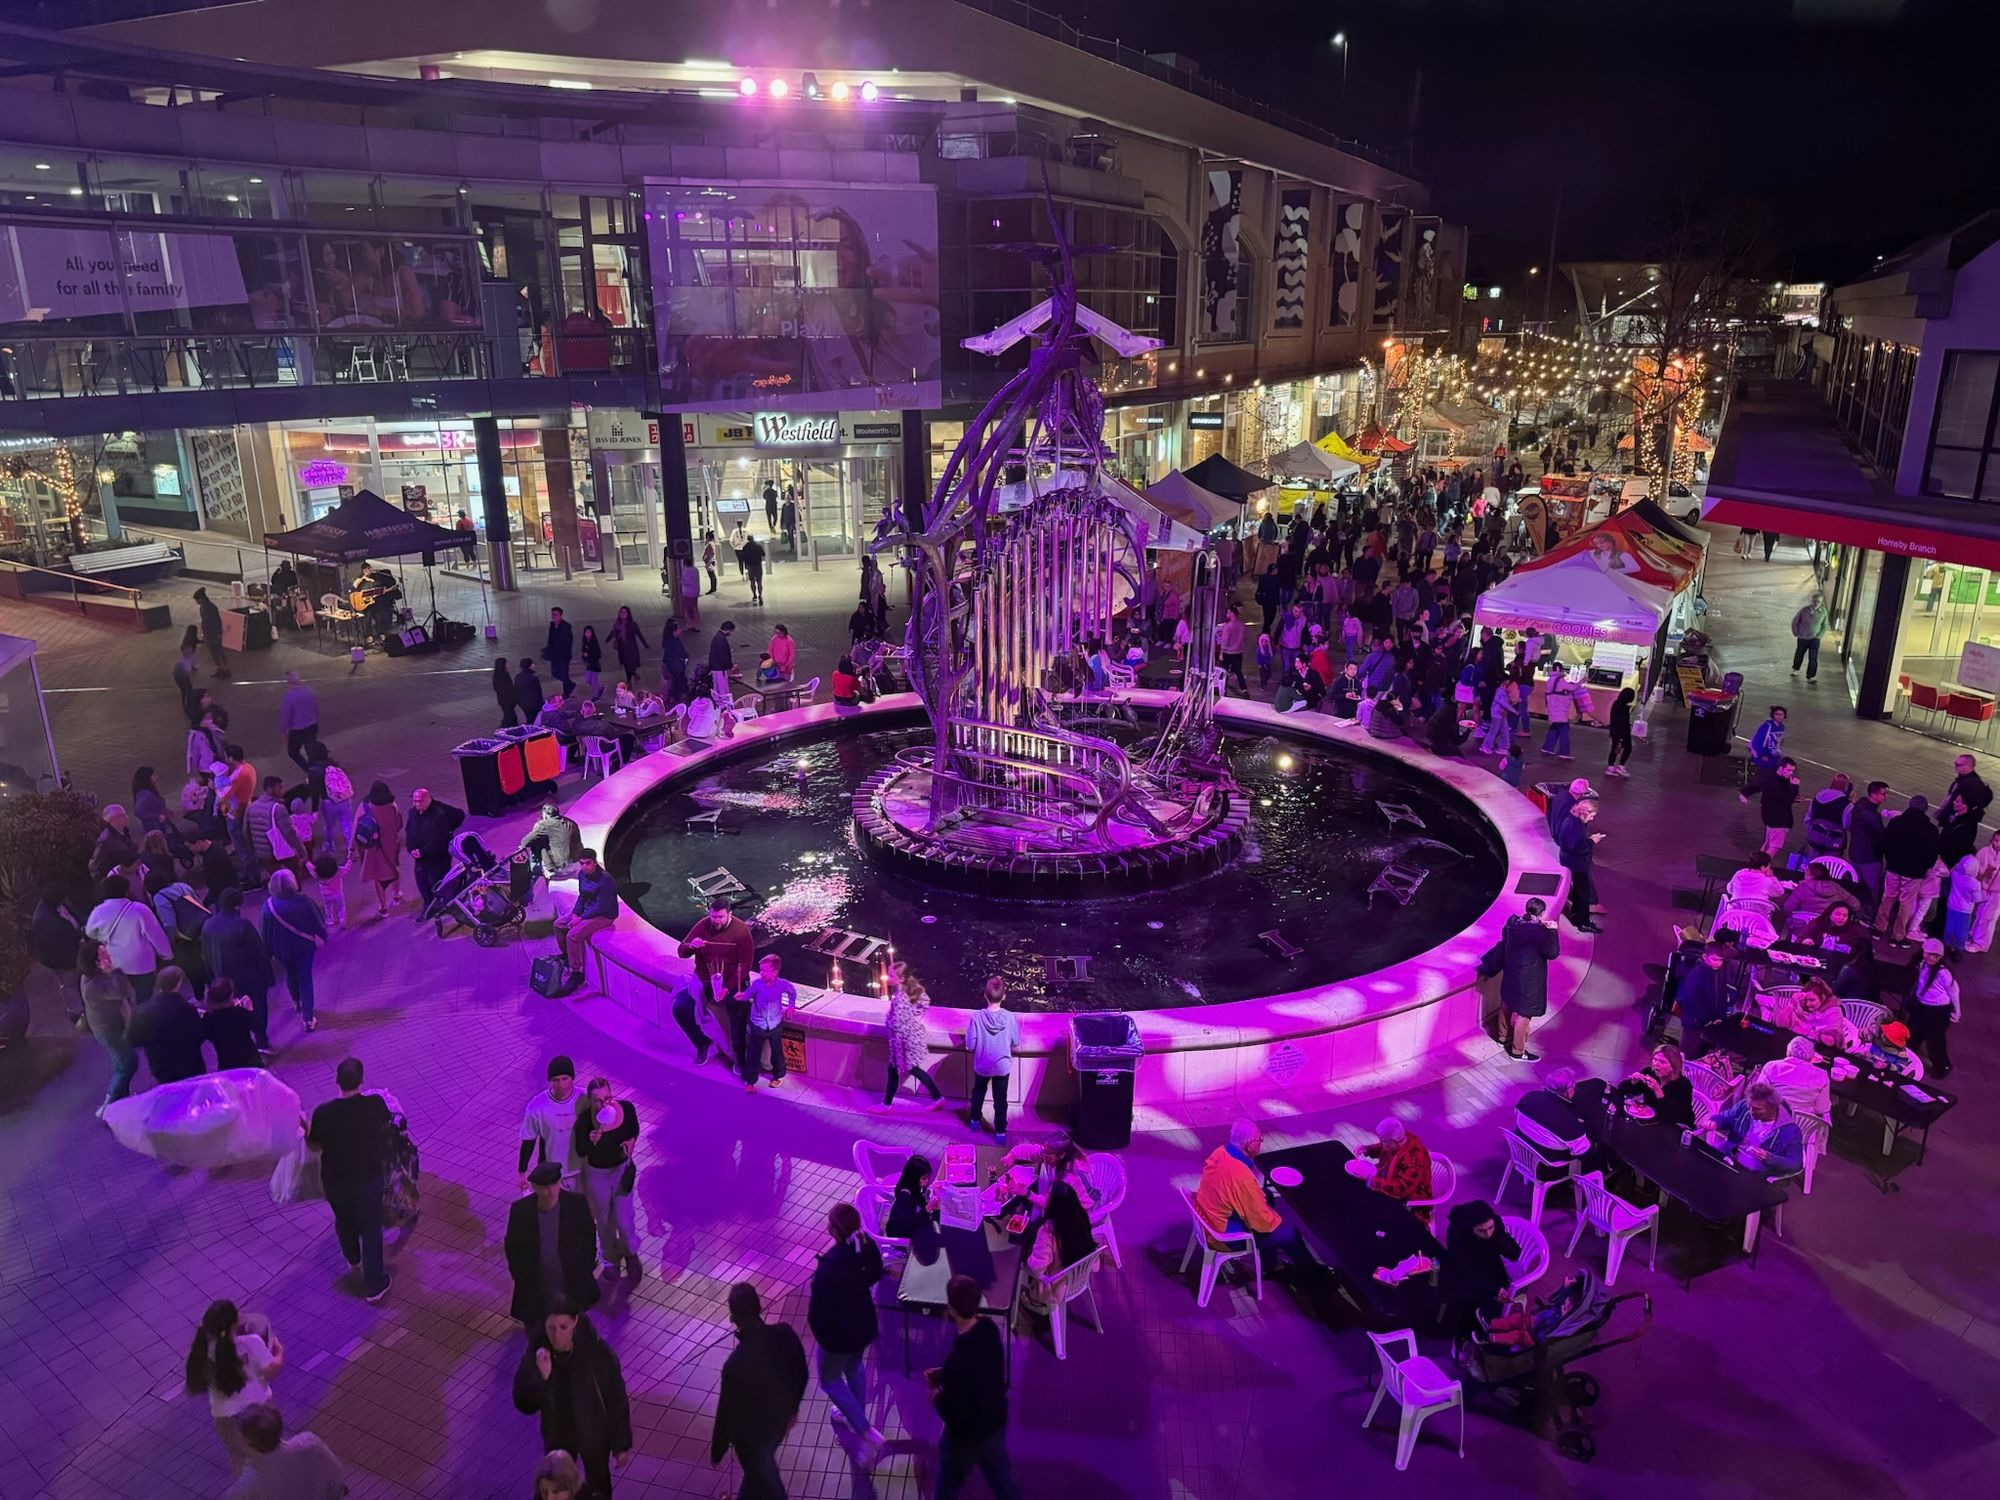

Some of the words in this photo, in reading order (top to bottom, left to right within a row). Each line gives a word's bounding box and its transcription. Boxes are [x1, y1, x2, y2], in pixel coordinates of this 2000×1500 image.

[65, 256, 84, 271] All
[88, 260, 115, 274] you
[56, 280, 78, 295] for
[83, 280, 100, 295] all
[136, 281, 182, 298] family
[757, 415, 836, 444] Westfield
[363, 522, 415, 537] HORNSBY
[1877, 536, 1908, 551] Hornsby
[1909, 541, 1937, 554] Branch
[1553, 622, 1608, 637] COOKIES
